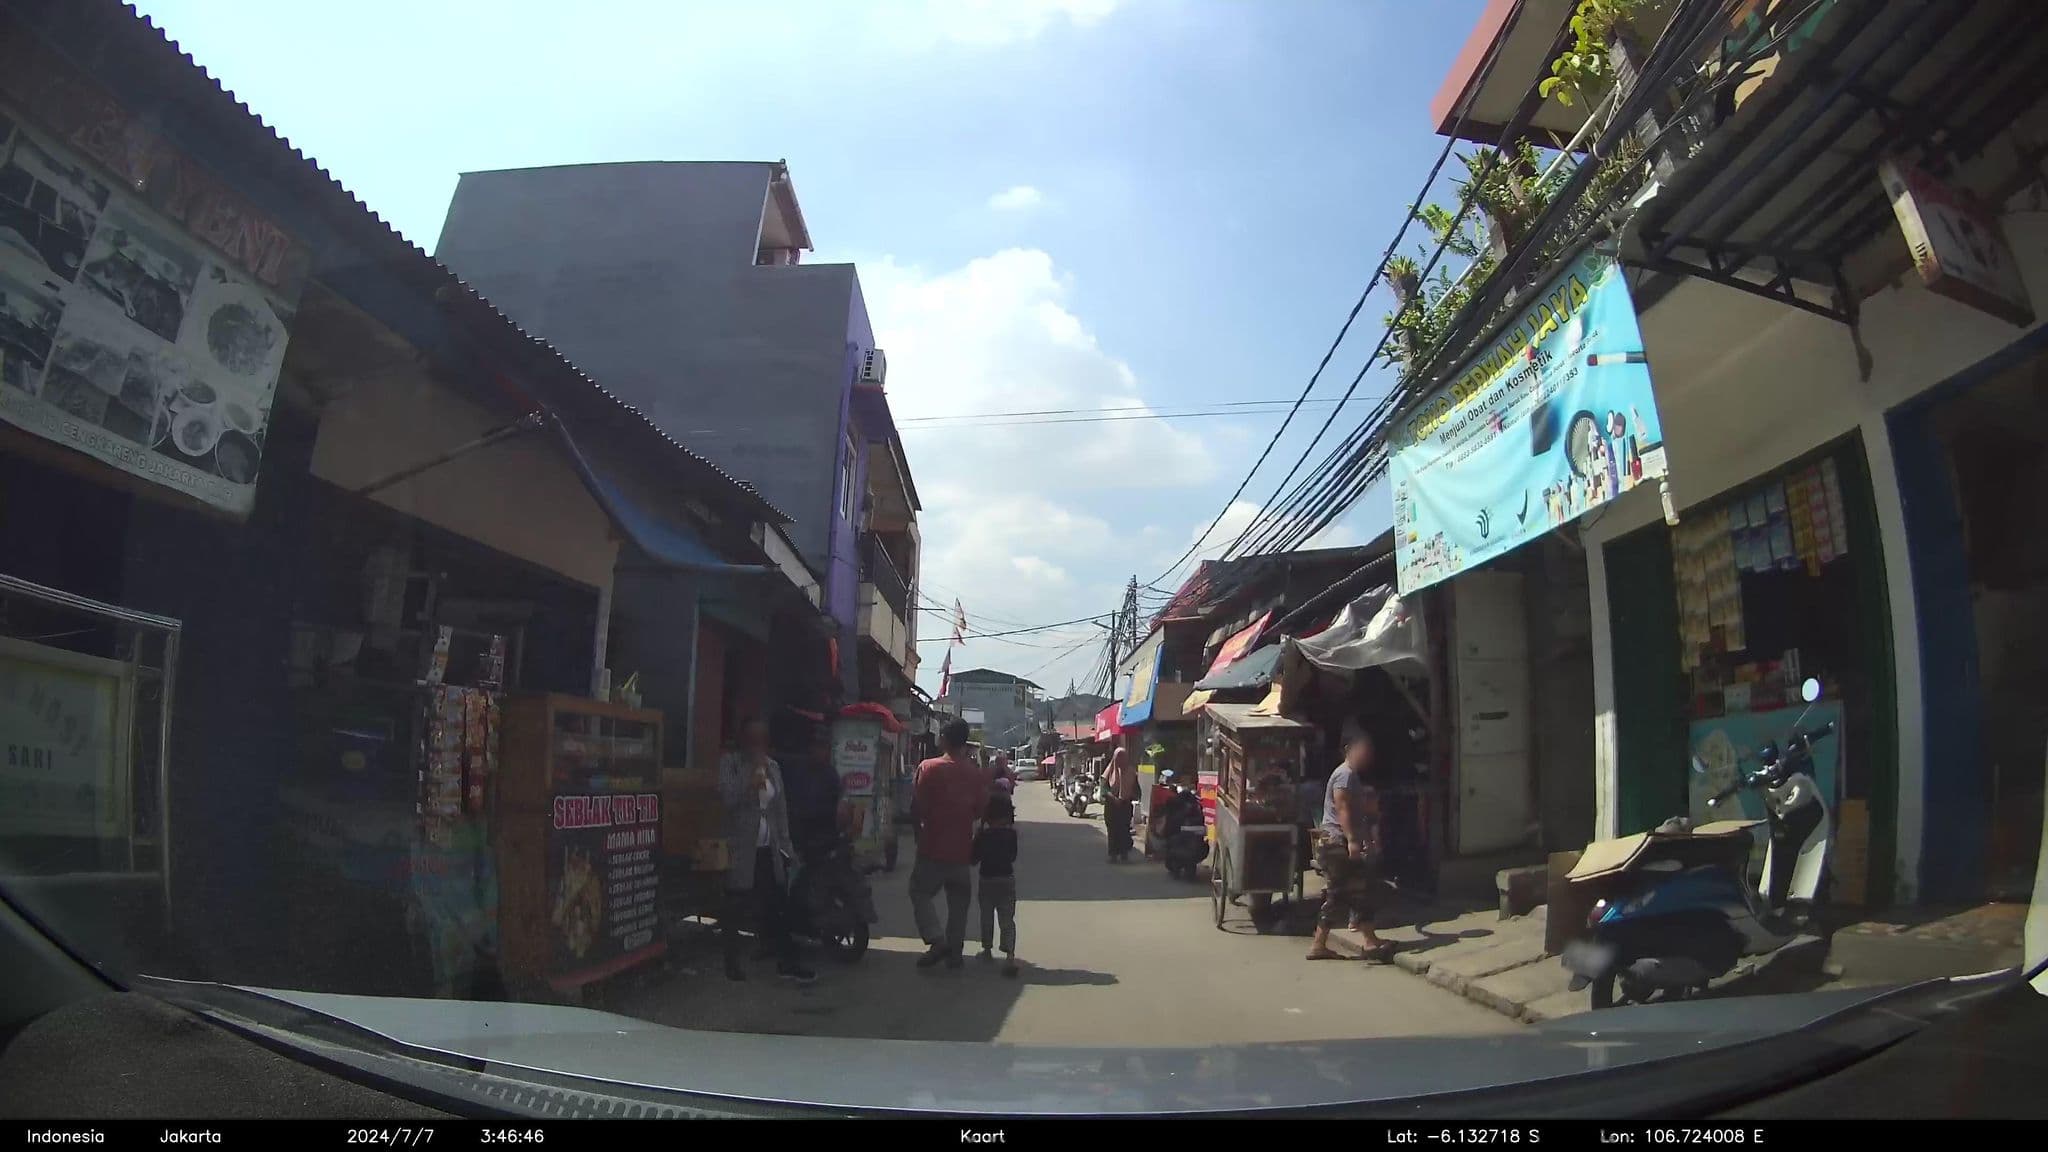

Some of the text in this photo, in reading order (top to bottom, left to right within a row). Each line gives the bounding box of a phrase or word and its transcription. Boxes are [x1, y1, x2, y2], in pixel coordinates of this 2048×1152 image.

[1407, 396, 1450, 446] TOKO
[1449, 327, 1530, 414] BERKAH
[1526, 272, 1591, 350] JAYA
[1439, 410, 1467, 445] Menjual
[1467, 396, 1488, 425] Obat
[1487, 387, 1506, 413] dan
[1505, 349, 1554, 397] Kosmetik
[553, 795, 612, 830] SEBLAK
[607, 831, 636, 849] MAMA
